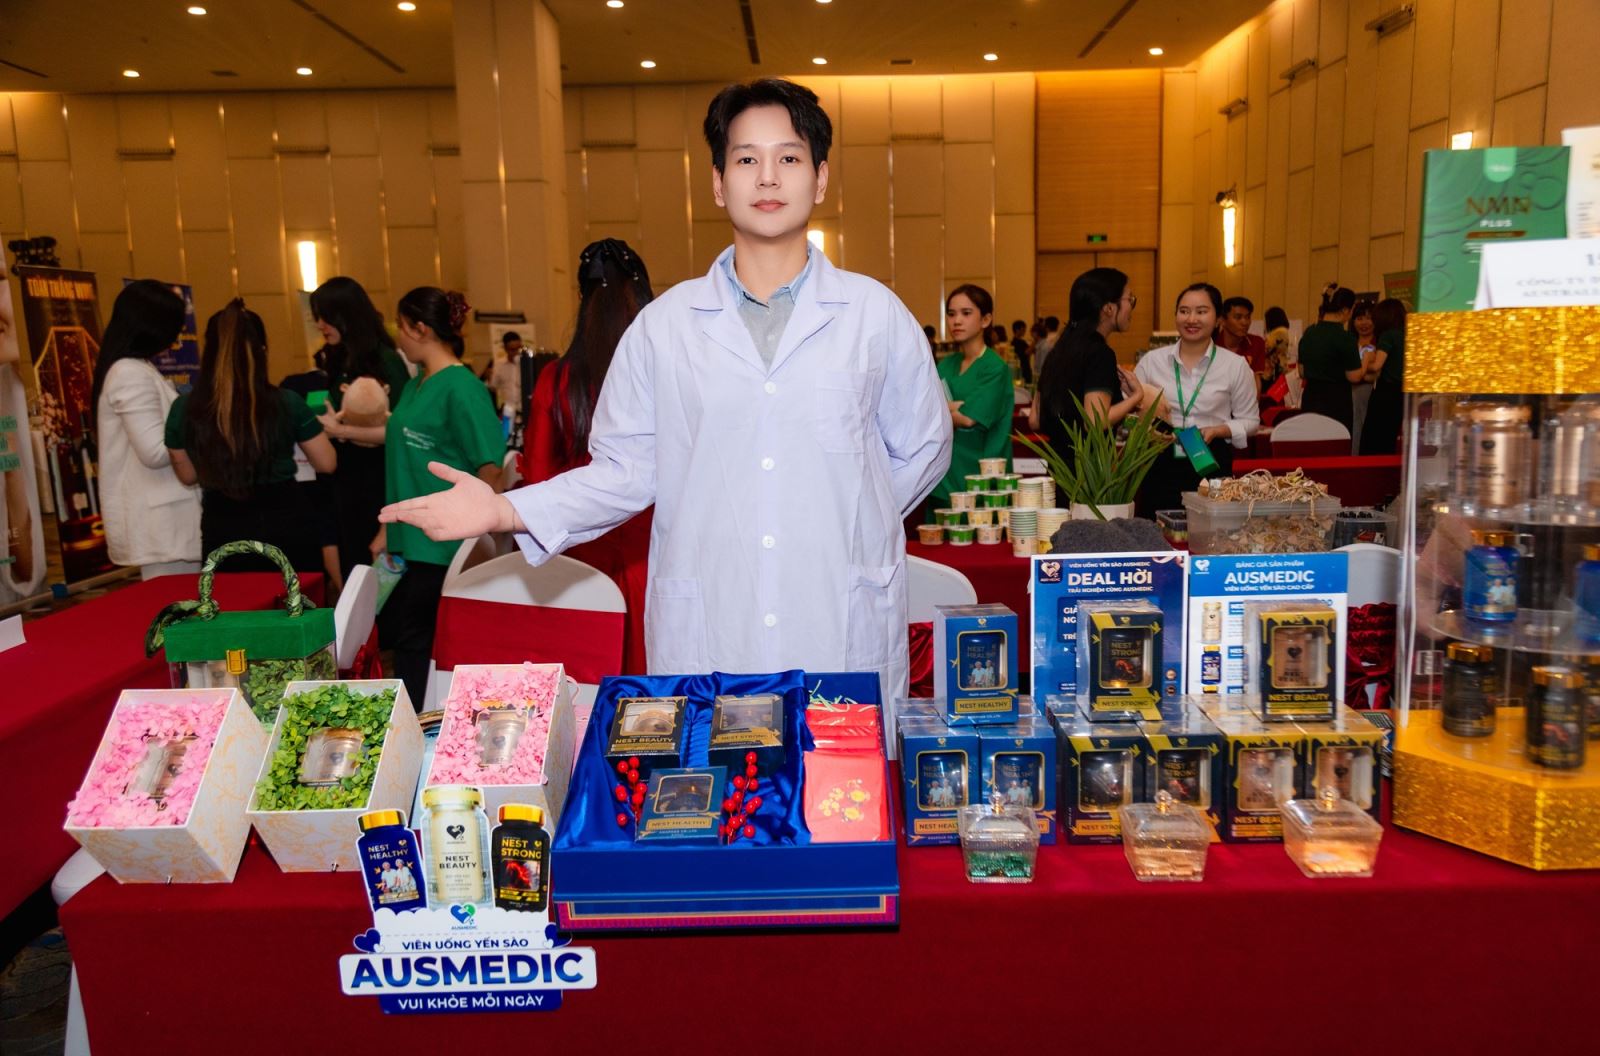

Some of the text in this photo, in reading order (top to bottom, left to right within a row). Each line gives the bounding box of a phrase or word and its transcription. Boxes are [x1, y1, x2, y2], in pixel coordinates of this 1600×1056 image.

[1480, 219, 1512, 228] PLUS
[1068, 569, 1153, 586] DEAL HỜI
[1224, 570, 1315, 585] AUSMEDIC
[1294, 693, 1329, 701] BEAUTY
[978, 701, 1008, 709] HEALTHY
[1234, 816, 1257, 824] NEST
[367, 844, 390, 853] NEST
[501, 839, 529, 848] NEST
[369, 848, 409, 860] HEALTHY
[501, 848, 542, 859] STRONG
[402, 936, 529, 950] VIÊN UỐNG YẾN SÀO
[351, 952, 584, 988] AUSMEDIC
[398, 992, 544, 1009] VUI KHỎE MỖI NGÀY
